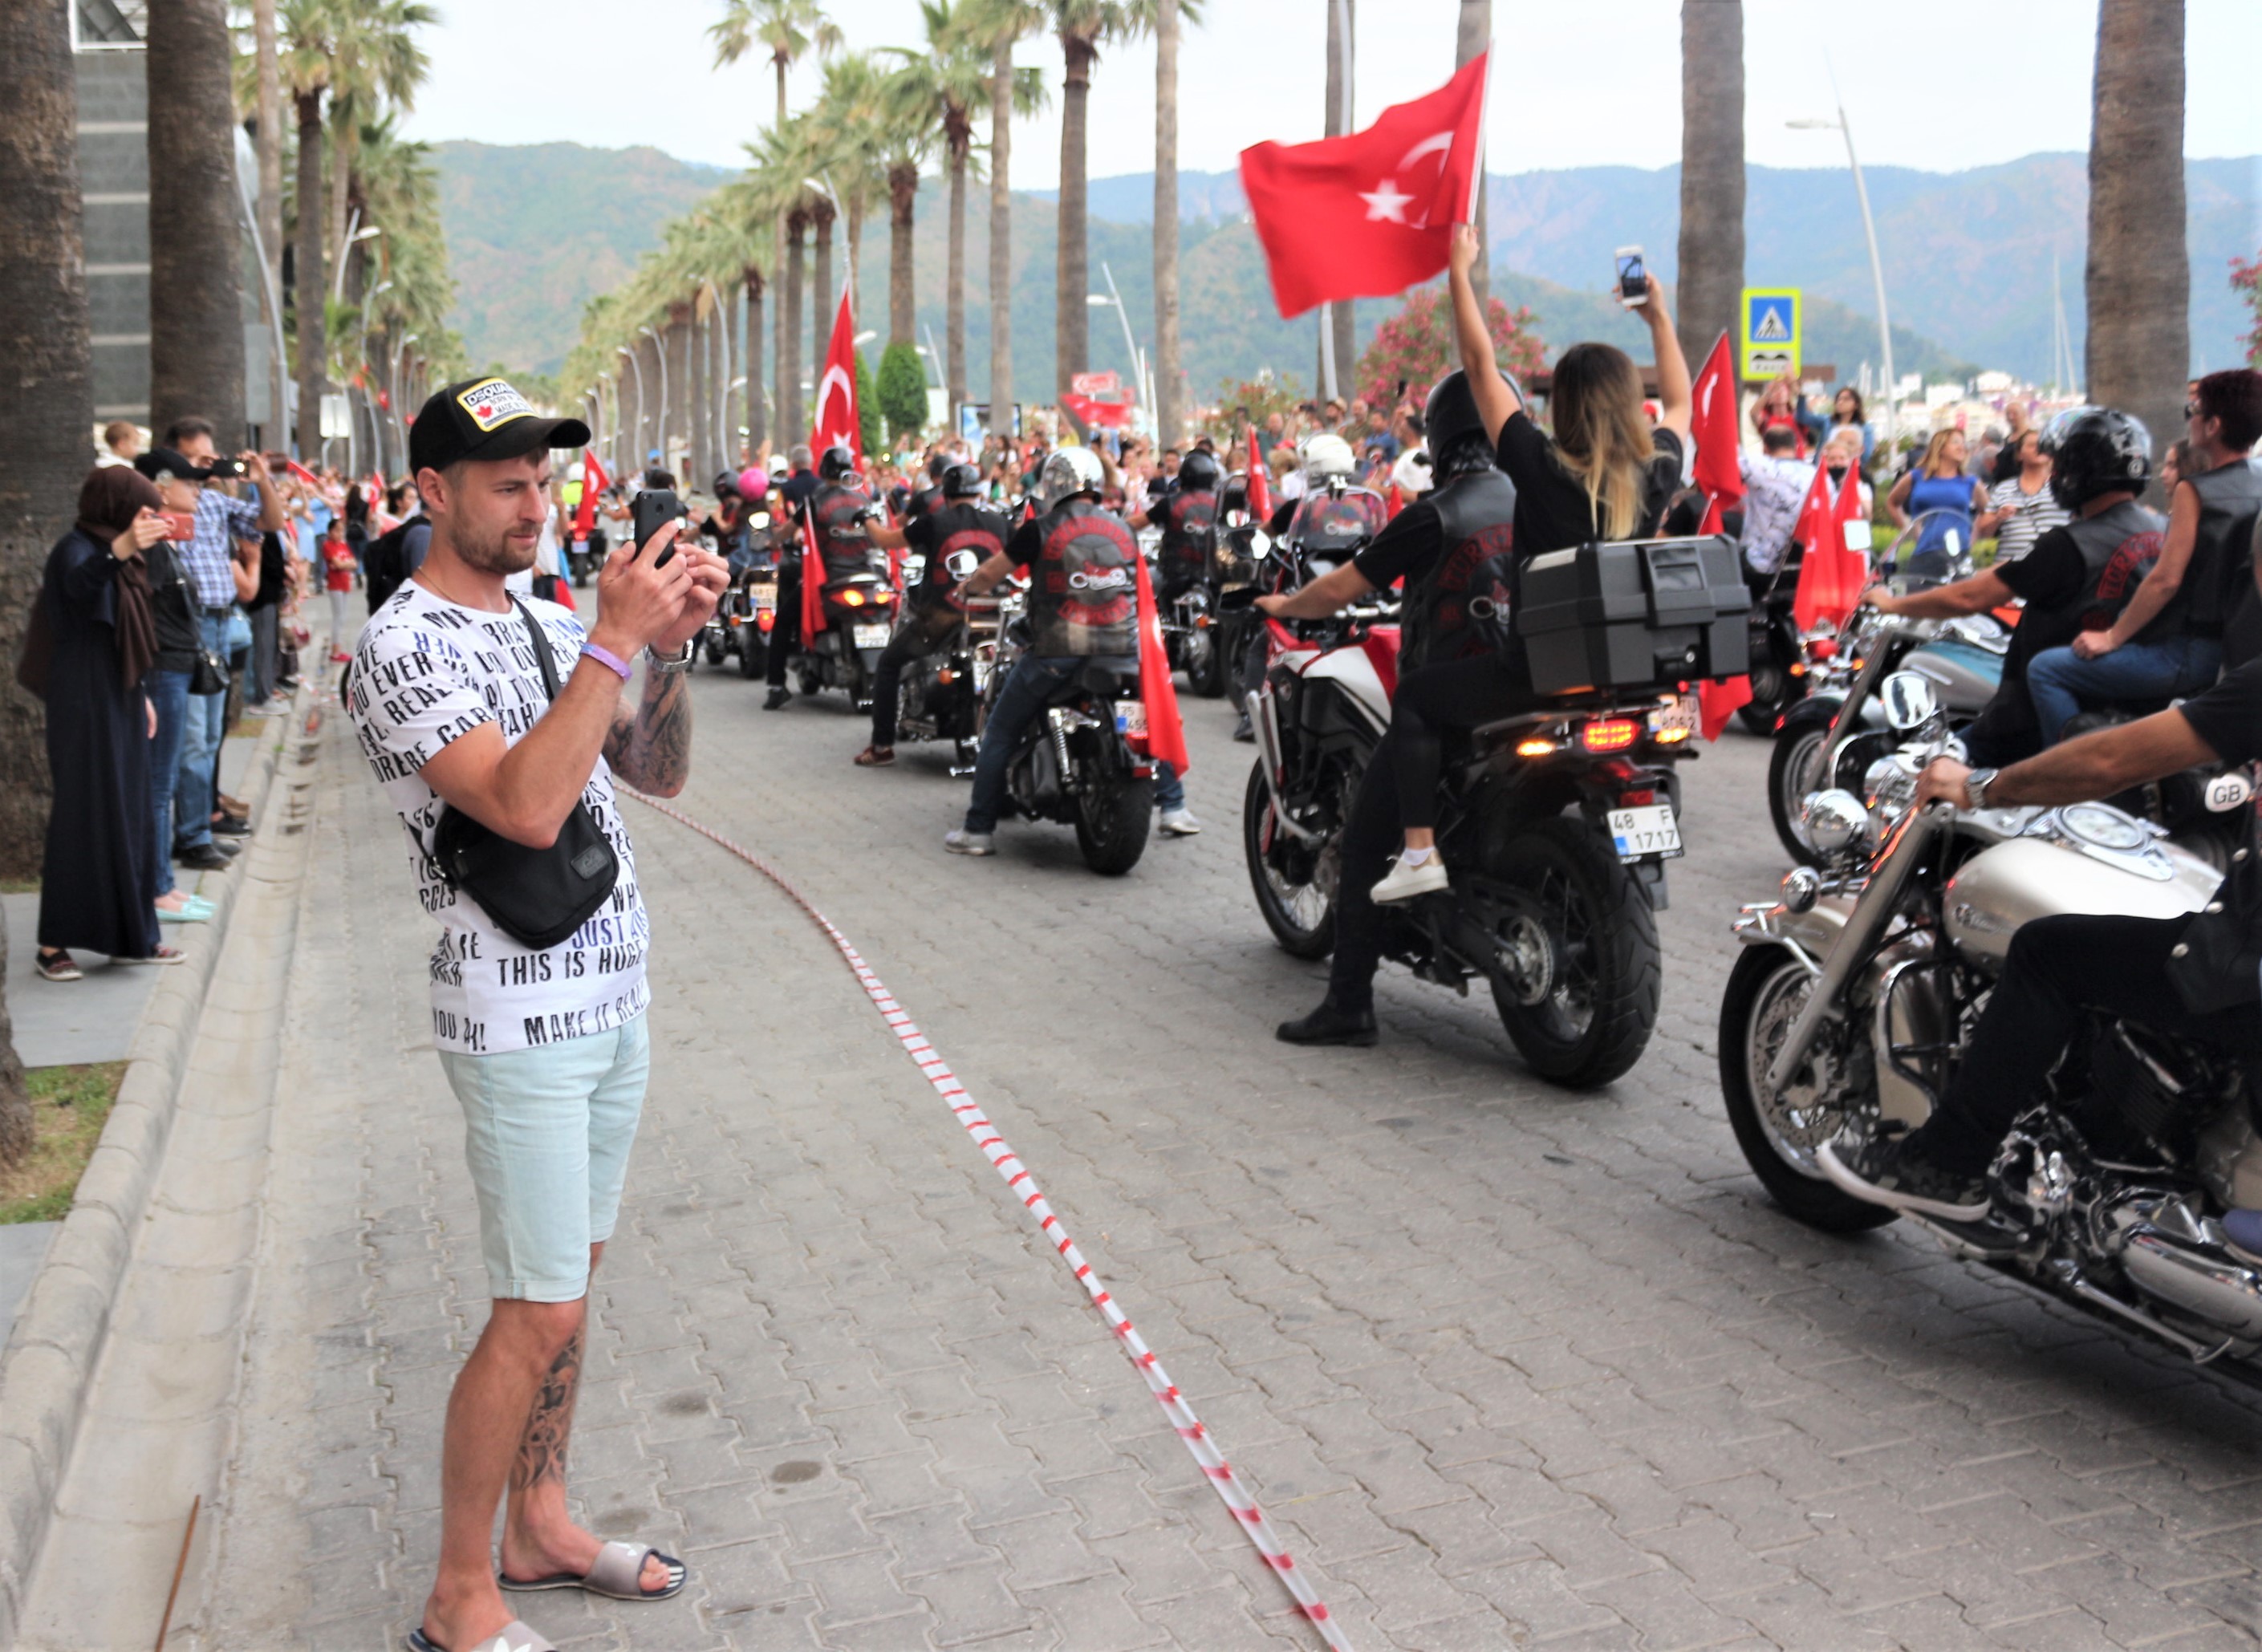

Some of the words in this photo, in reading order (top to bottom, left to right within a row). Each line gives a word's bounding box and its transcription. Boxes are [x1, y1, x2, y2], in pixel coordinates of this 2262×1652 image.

[371, 651, 435, 696] EVER
[2214, 785, 2241, 805] GB
[1614, 812, 1635, 830] 48
[1660, 809, 1669, 825] F
[1635, 830, 1675, 849] 1717
[572, 916, 624, 949] JUST
[497, 953, 552, 987] THIS
[565, 951, 586, 979] IS
[523, 1009, 587, 1046] MAKE
[595, 1002, 610, 1033] IT
